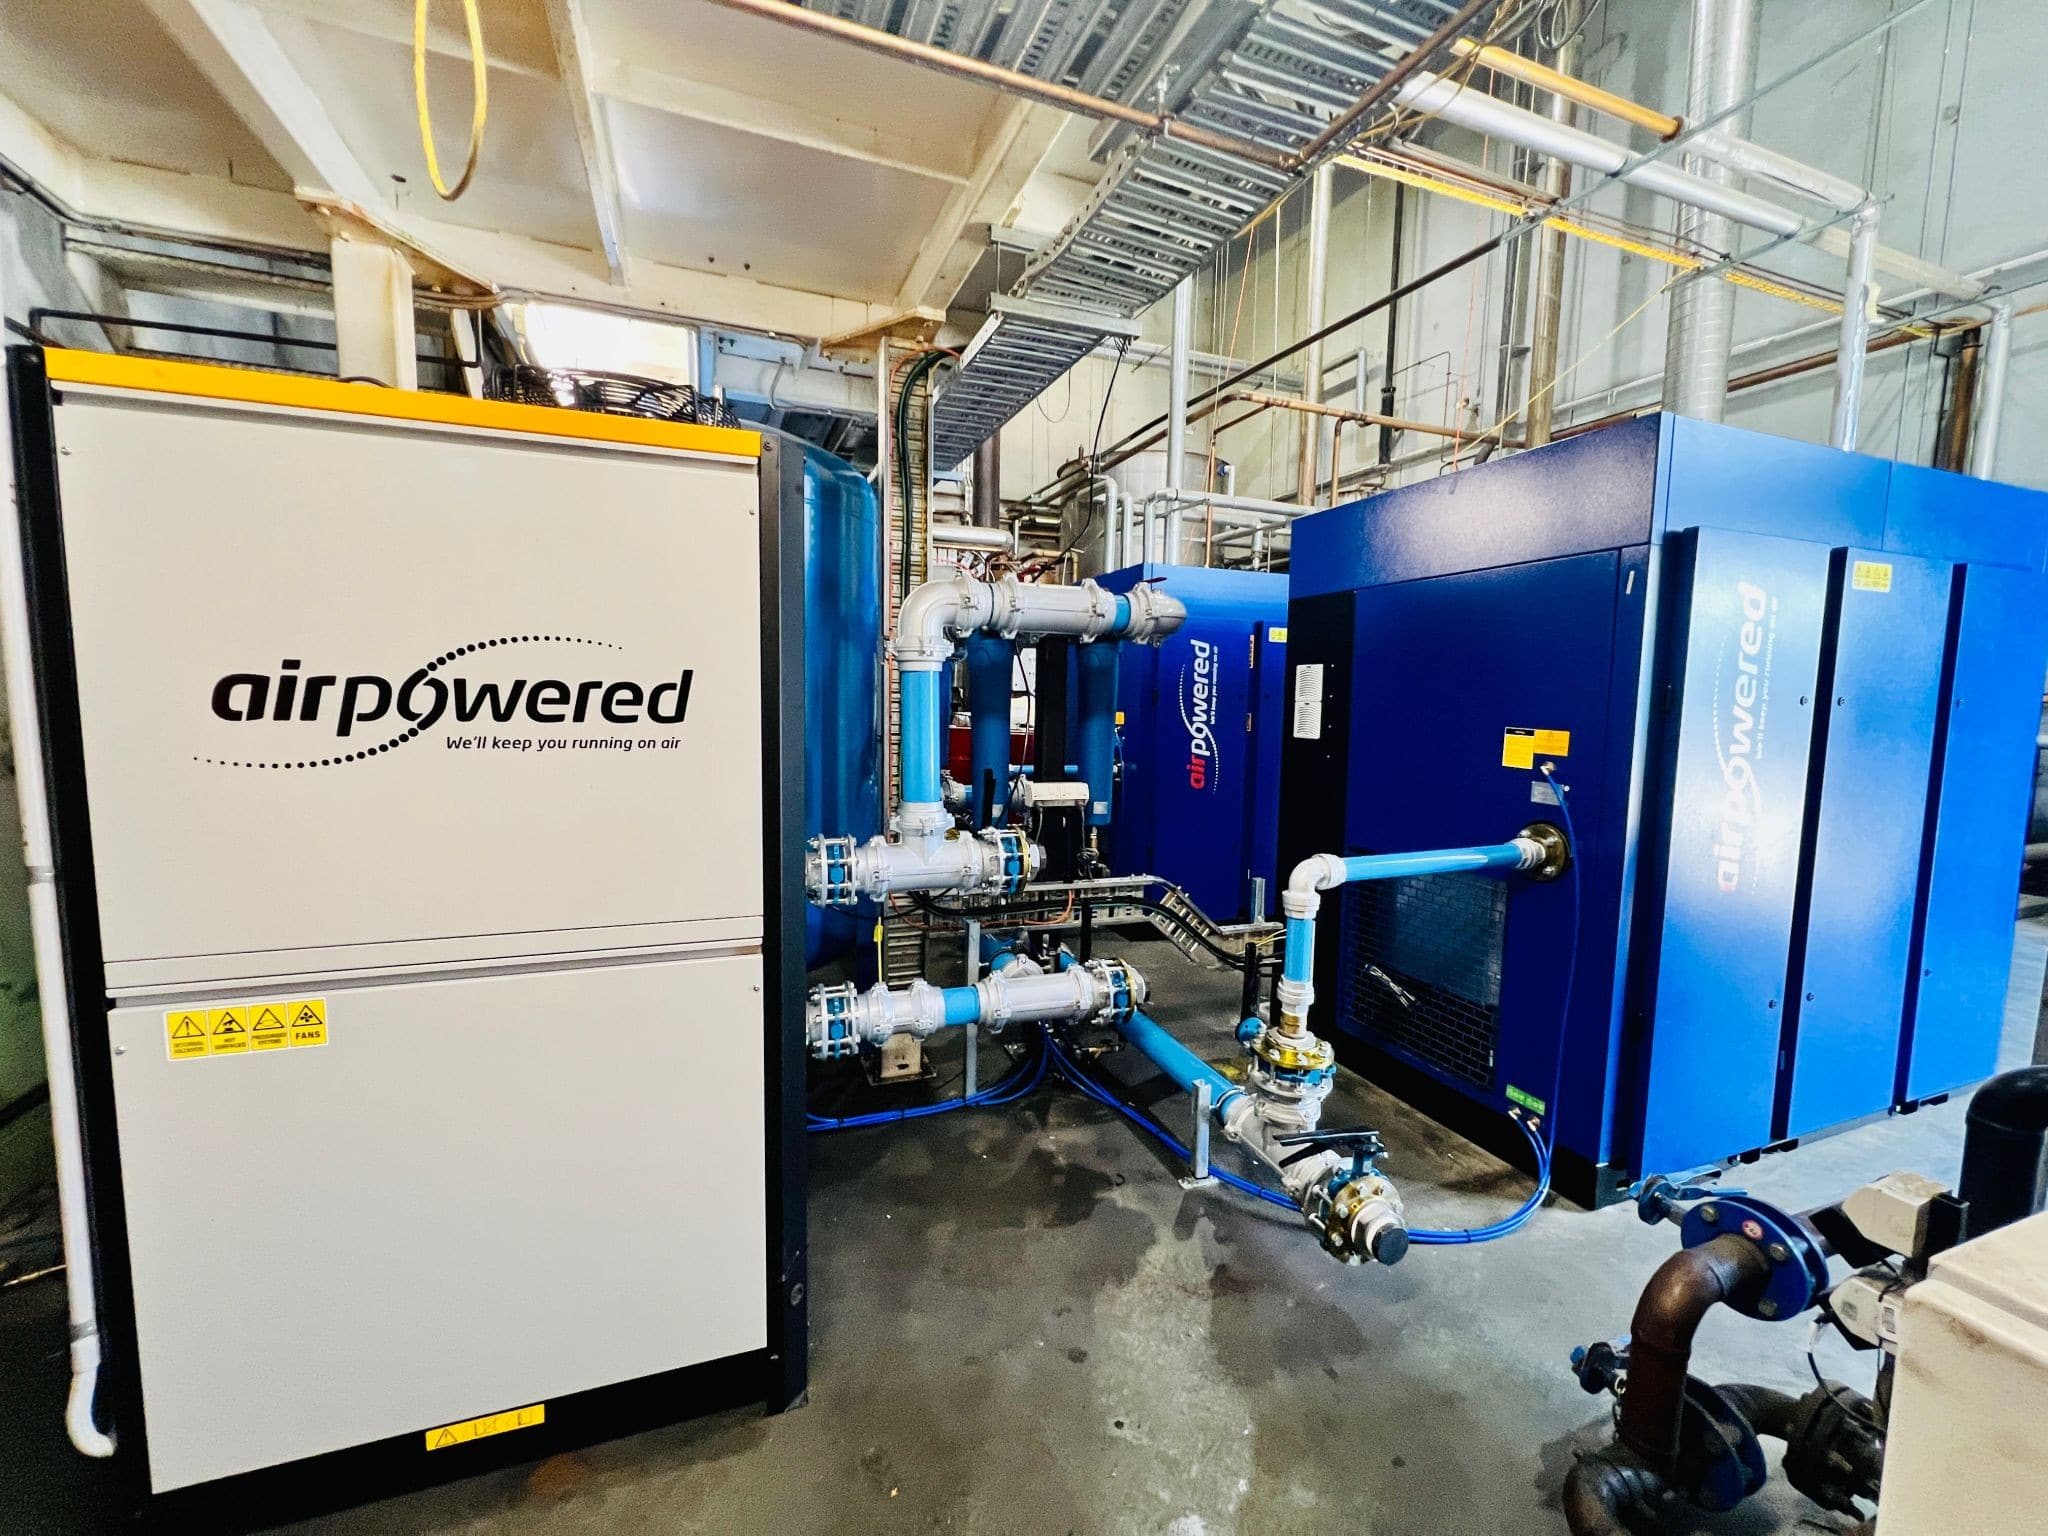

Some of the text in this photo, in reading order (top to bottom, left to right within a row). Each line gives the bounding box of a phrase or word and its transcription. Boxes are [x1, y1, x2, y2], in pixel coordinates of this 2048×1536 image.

[211, 658, 694, 737] airpowered
[1186, 638, 1211, 790] airpowered
[491, 736, 533, 752] keep
[537, 739, 567, 752] you
[572, 736, 633, 752] running
[637, 739, 656, 749] on
[661, 737, 681, 749] air
[295, 1030, 321, 1040] FANS
